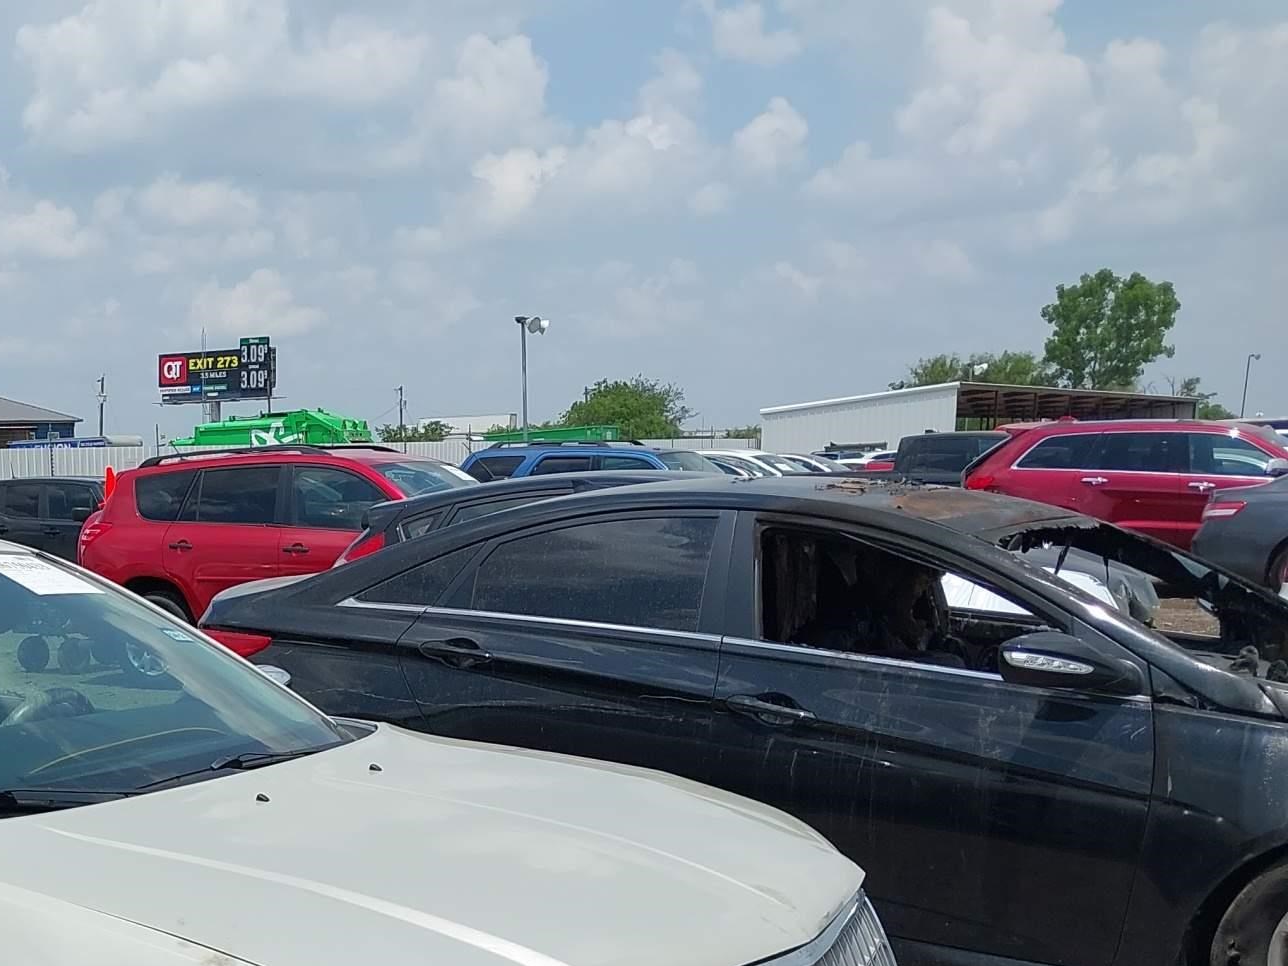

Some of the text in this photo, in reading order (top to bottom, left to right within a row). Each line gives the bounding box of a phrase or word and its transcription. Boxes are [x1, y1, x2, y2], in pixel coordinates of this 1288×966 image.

[189, 358, 214, 370] EXIT
[216, 356, 239, 369] 273
[164, 361, 183, 381] QT
[209, 371, 227, 379] MILES
